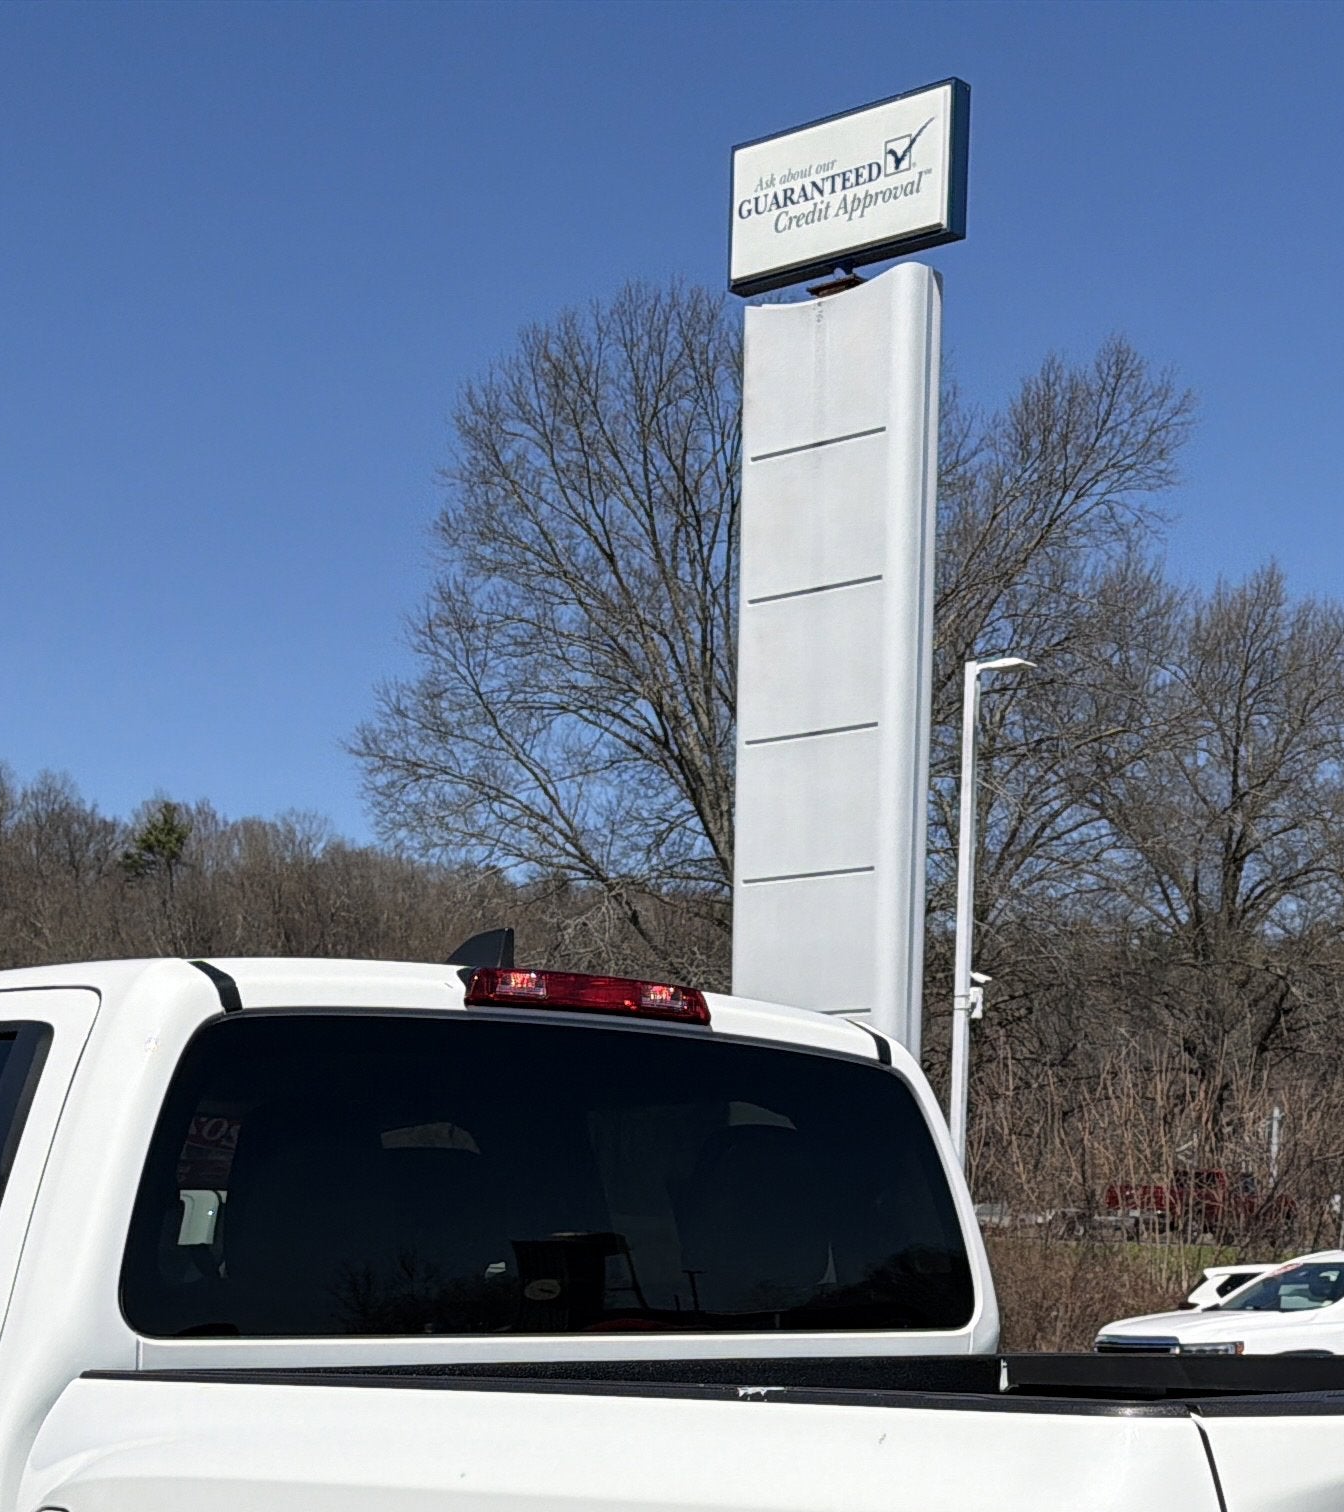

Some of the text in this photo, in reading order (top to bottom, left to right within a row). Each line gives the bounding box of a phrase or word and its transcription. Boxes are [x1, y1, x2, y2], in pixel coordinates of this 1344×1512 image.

[738, 161, 882, 220] GUARANTEED
[754, 160, 837, 193] Ask about our
[774, 199, 831, 234] Credit
